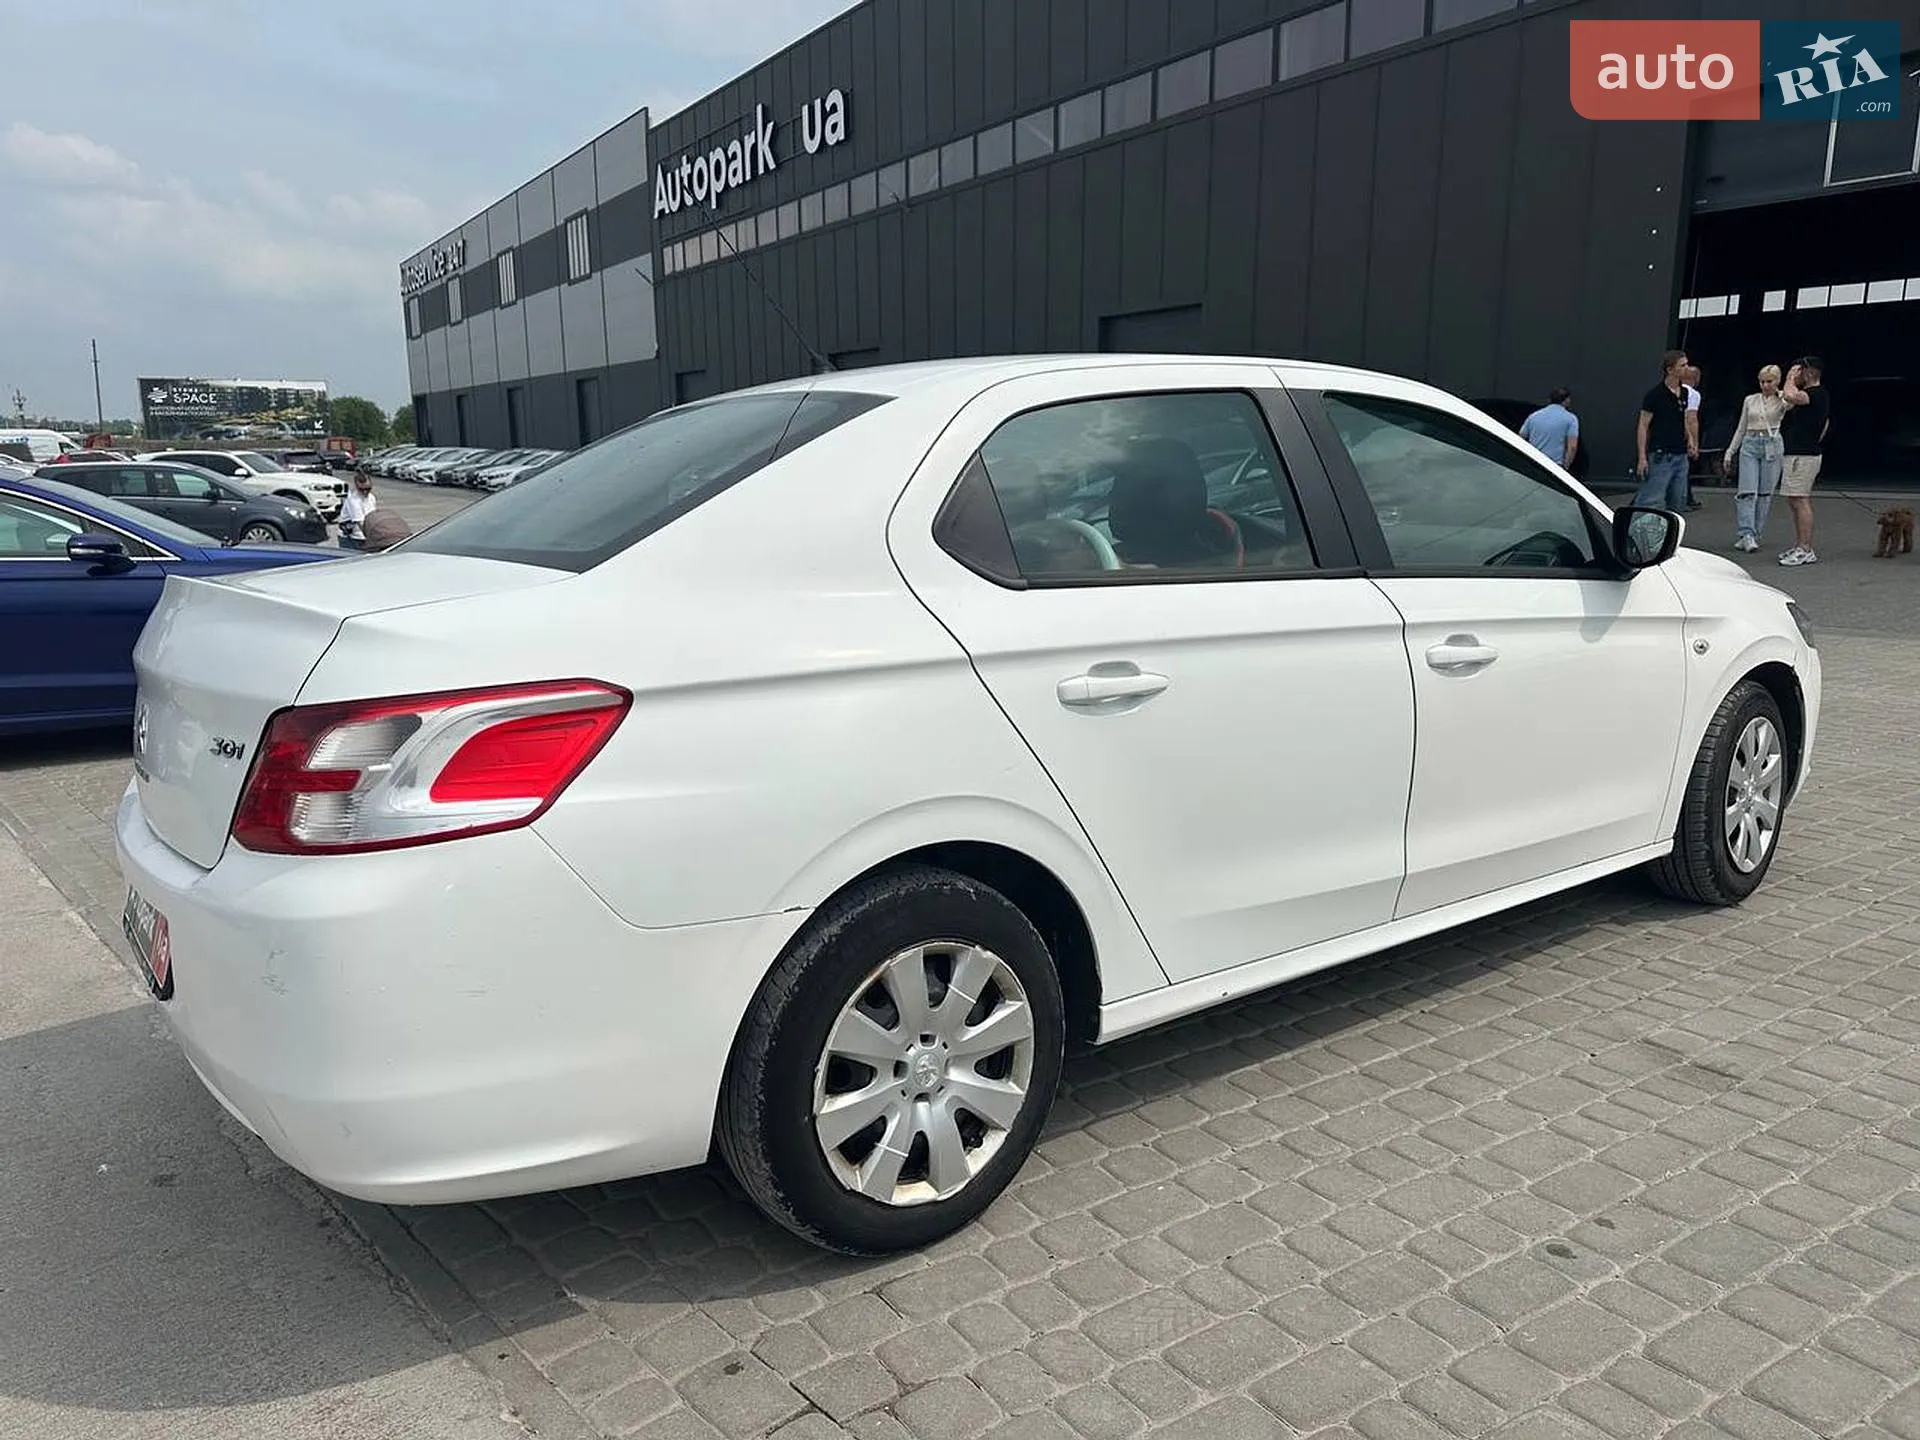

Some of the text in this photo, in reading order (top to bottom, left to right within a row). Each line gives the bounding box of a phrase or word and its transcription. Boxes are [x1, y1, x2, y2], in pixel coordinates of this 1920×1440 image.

[653, 88, 846, 219] Autopark ua
[173, 393, 217, 404] SPACE
[209, 737, 245, 760] 301
